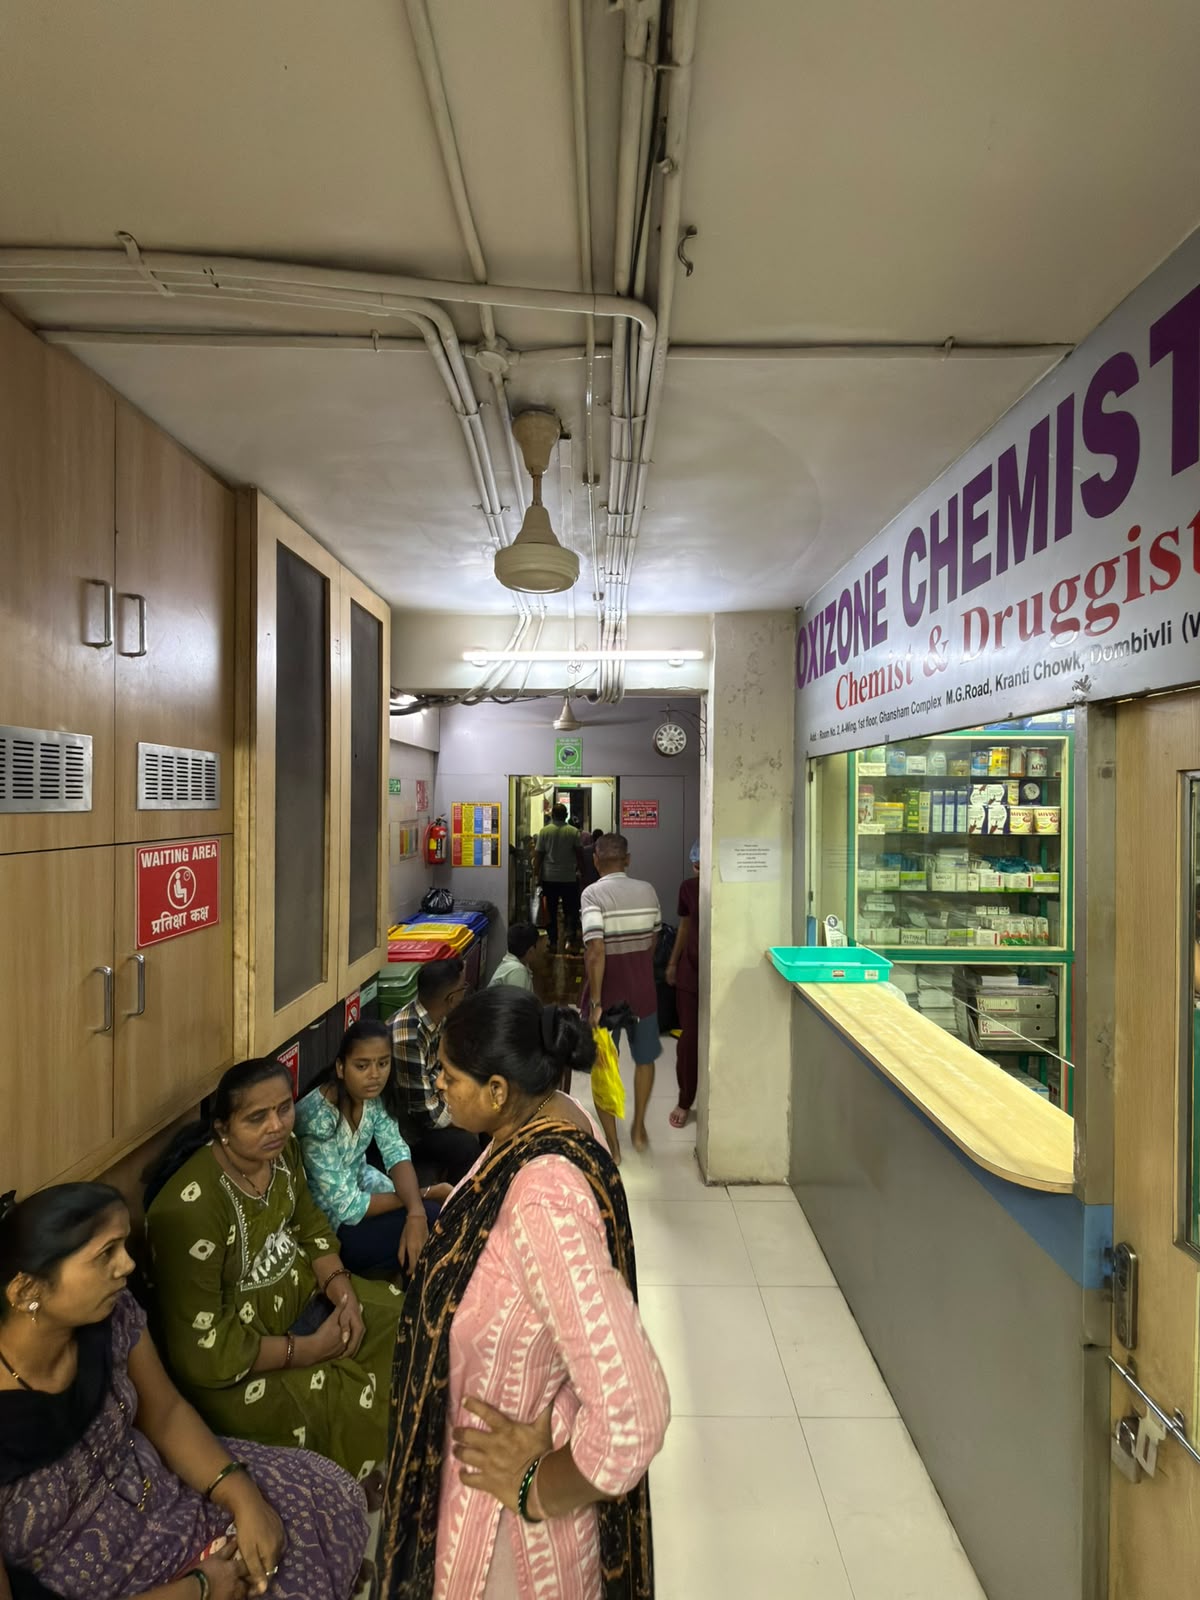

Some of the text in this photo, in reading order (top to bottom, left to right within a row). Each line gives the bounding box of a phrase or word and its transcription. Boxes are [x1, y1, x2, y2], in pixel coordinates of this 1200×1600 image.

[796, 283, 1200, 690] OXIZONE CHEMIST
[836, 643, 914, 711] Chemist
[923, 625, 949, 678] &
[879, 706, 910, 724] Ghansham
[910, 695, 942, 715] Complex
[946, 675, 993, 706] M.G.Road,
[995, 665, 1029, 692] Kranti
[1033, 649, 1085, 681] Chowk,
[1090, 620, 1172, 665] Dombivli
[141, 844, 217, 868] WAITING AREA
[190, 905, 209, 922] कक्ष
